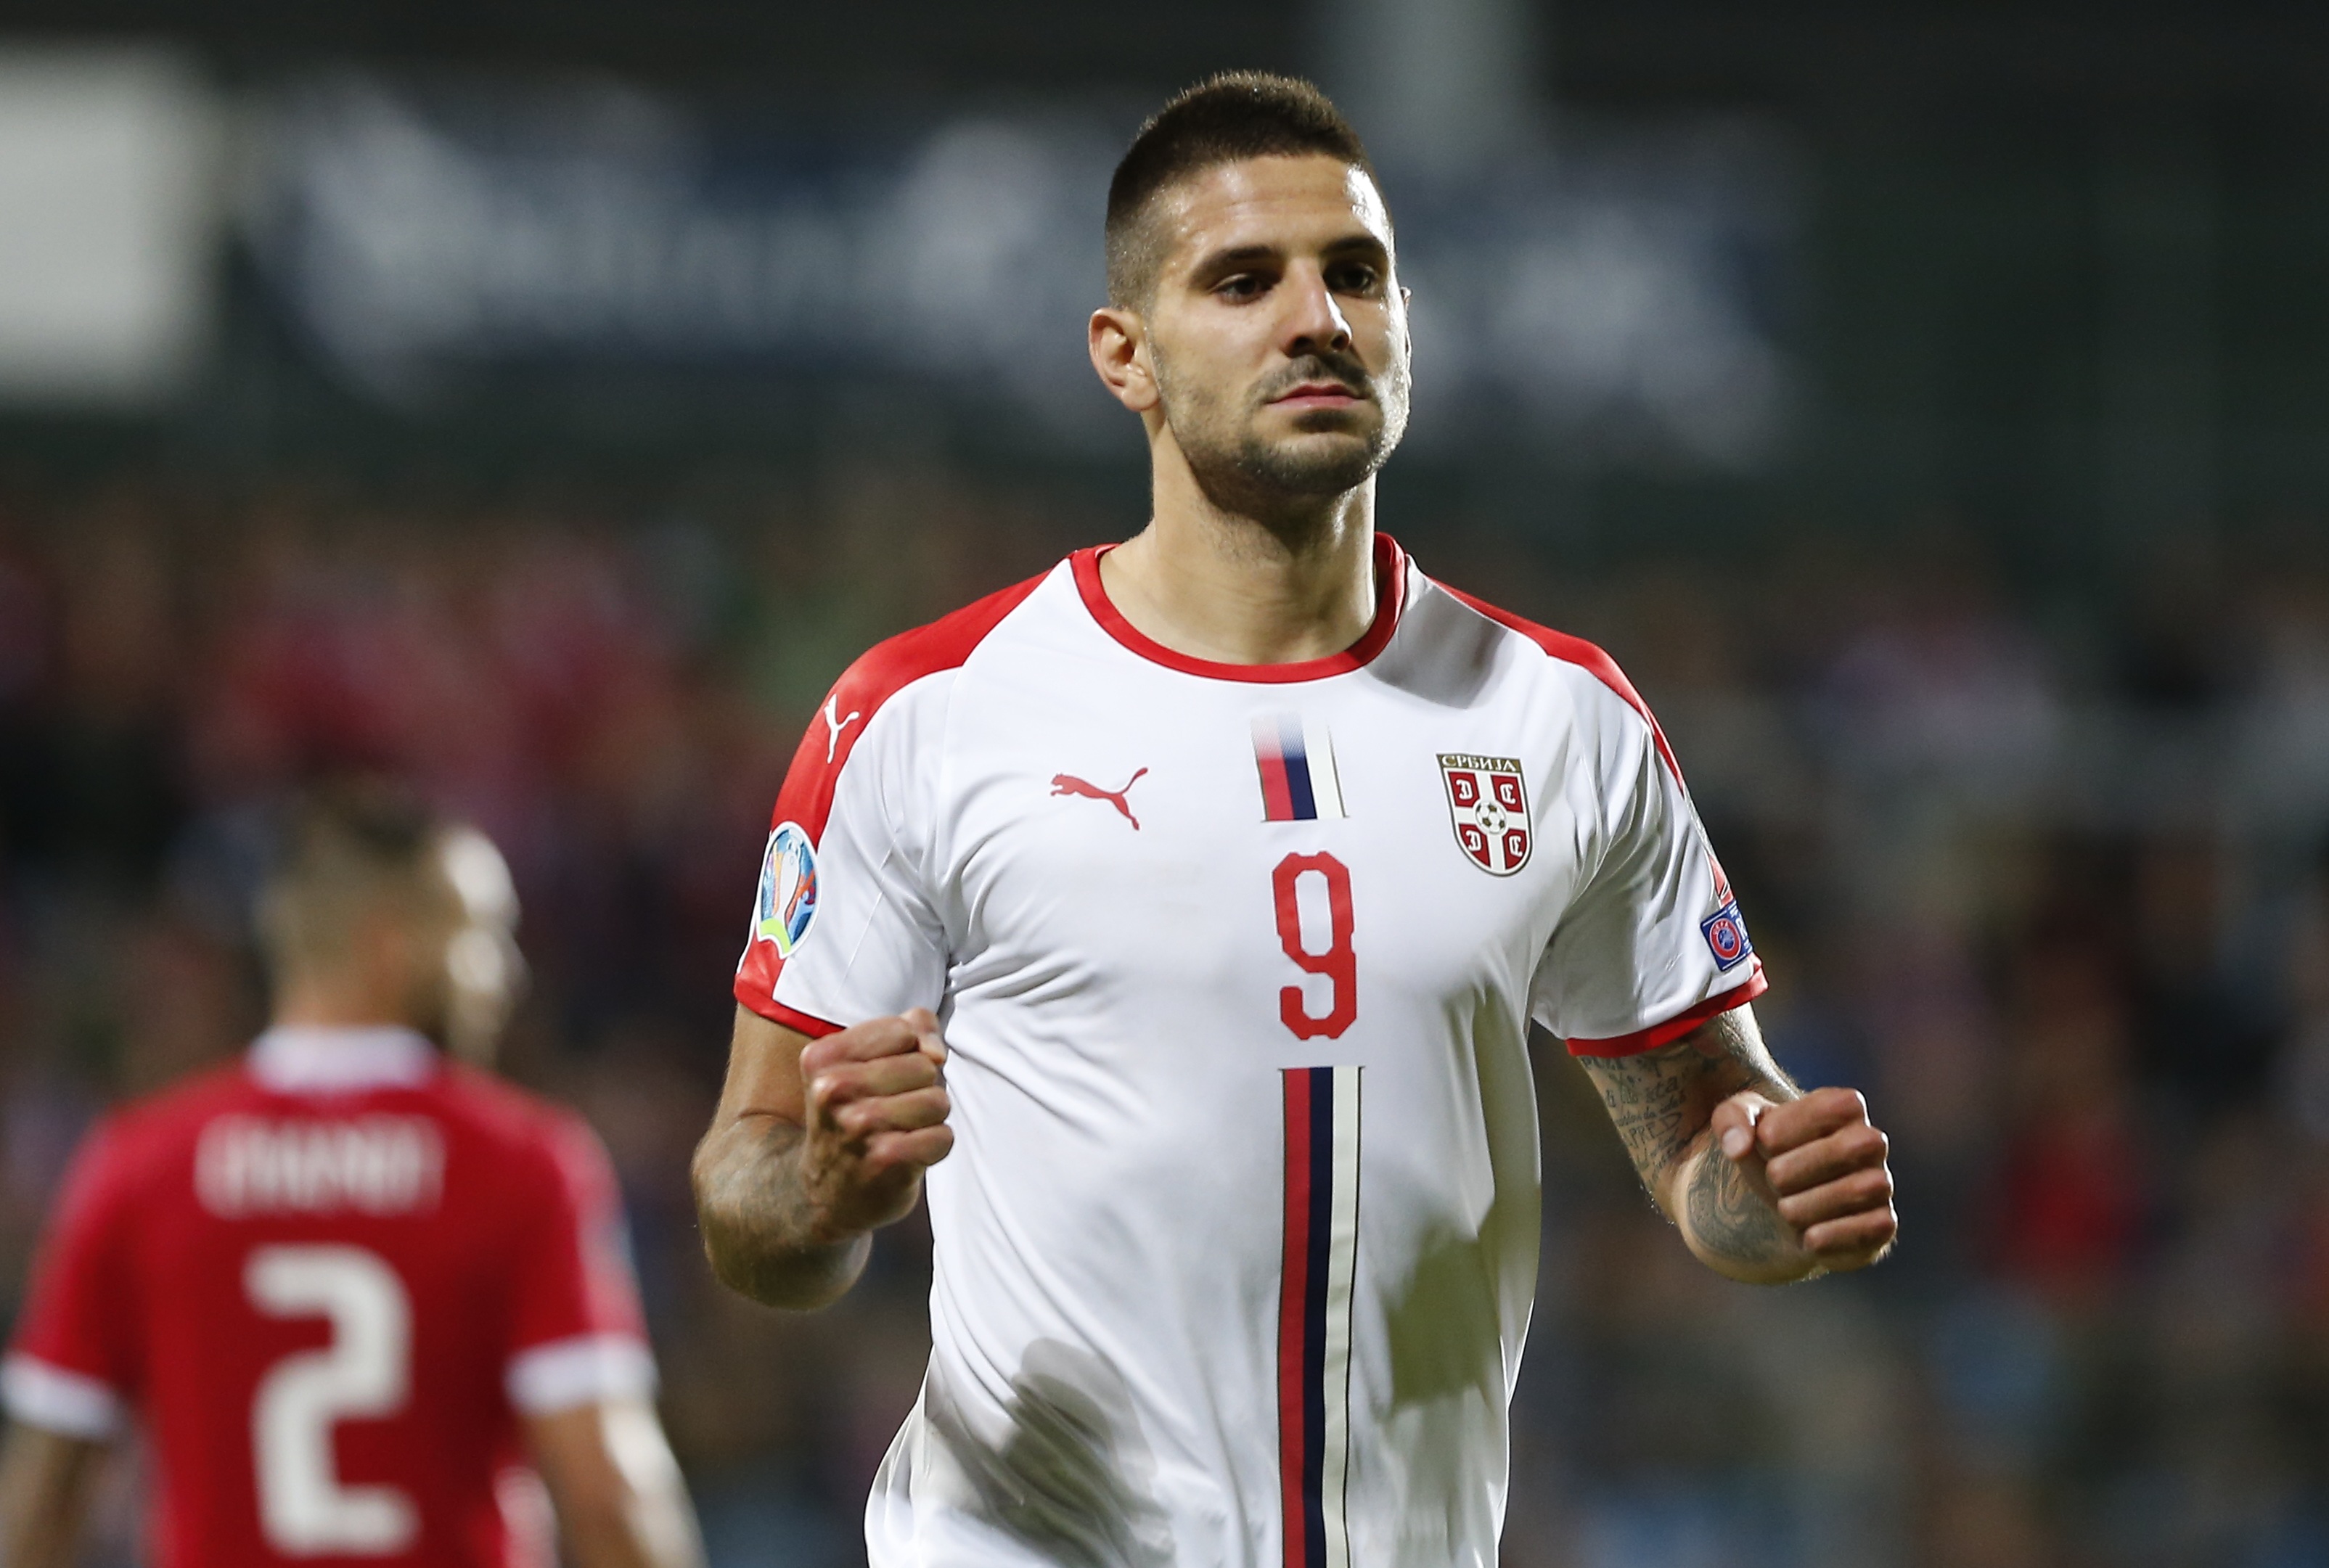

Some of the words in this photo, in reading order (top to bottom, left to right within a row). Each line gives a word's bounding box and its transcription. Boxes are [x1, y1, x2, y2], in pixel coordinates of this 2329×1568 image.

[1441, 755, 1517, 771] СРБИЈА
[1272, 850, 1356, 1040] 9
[243, 1244, 421, 1556] 2
